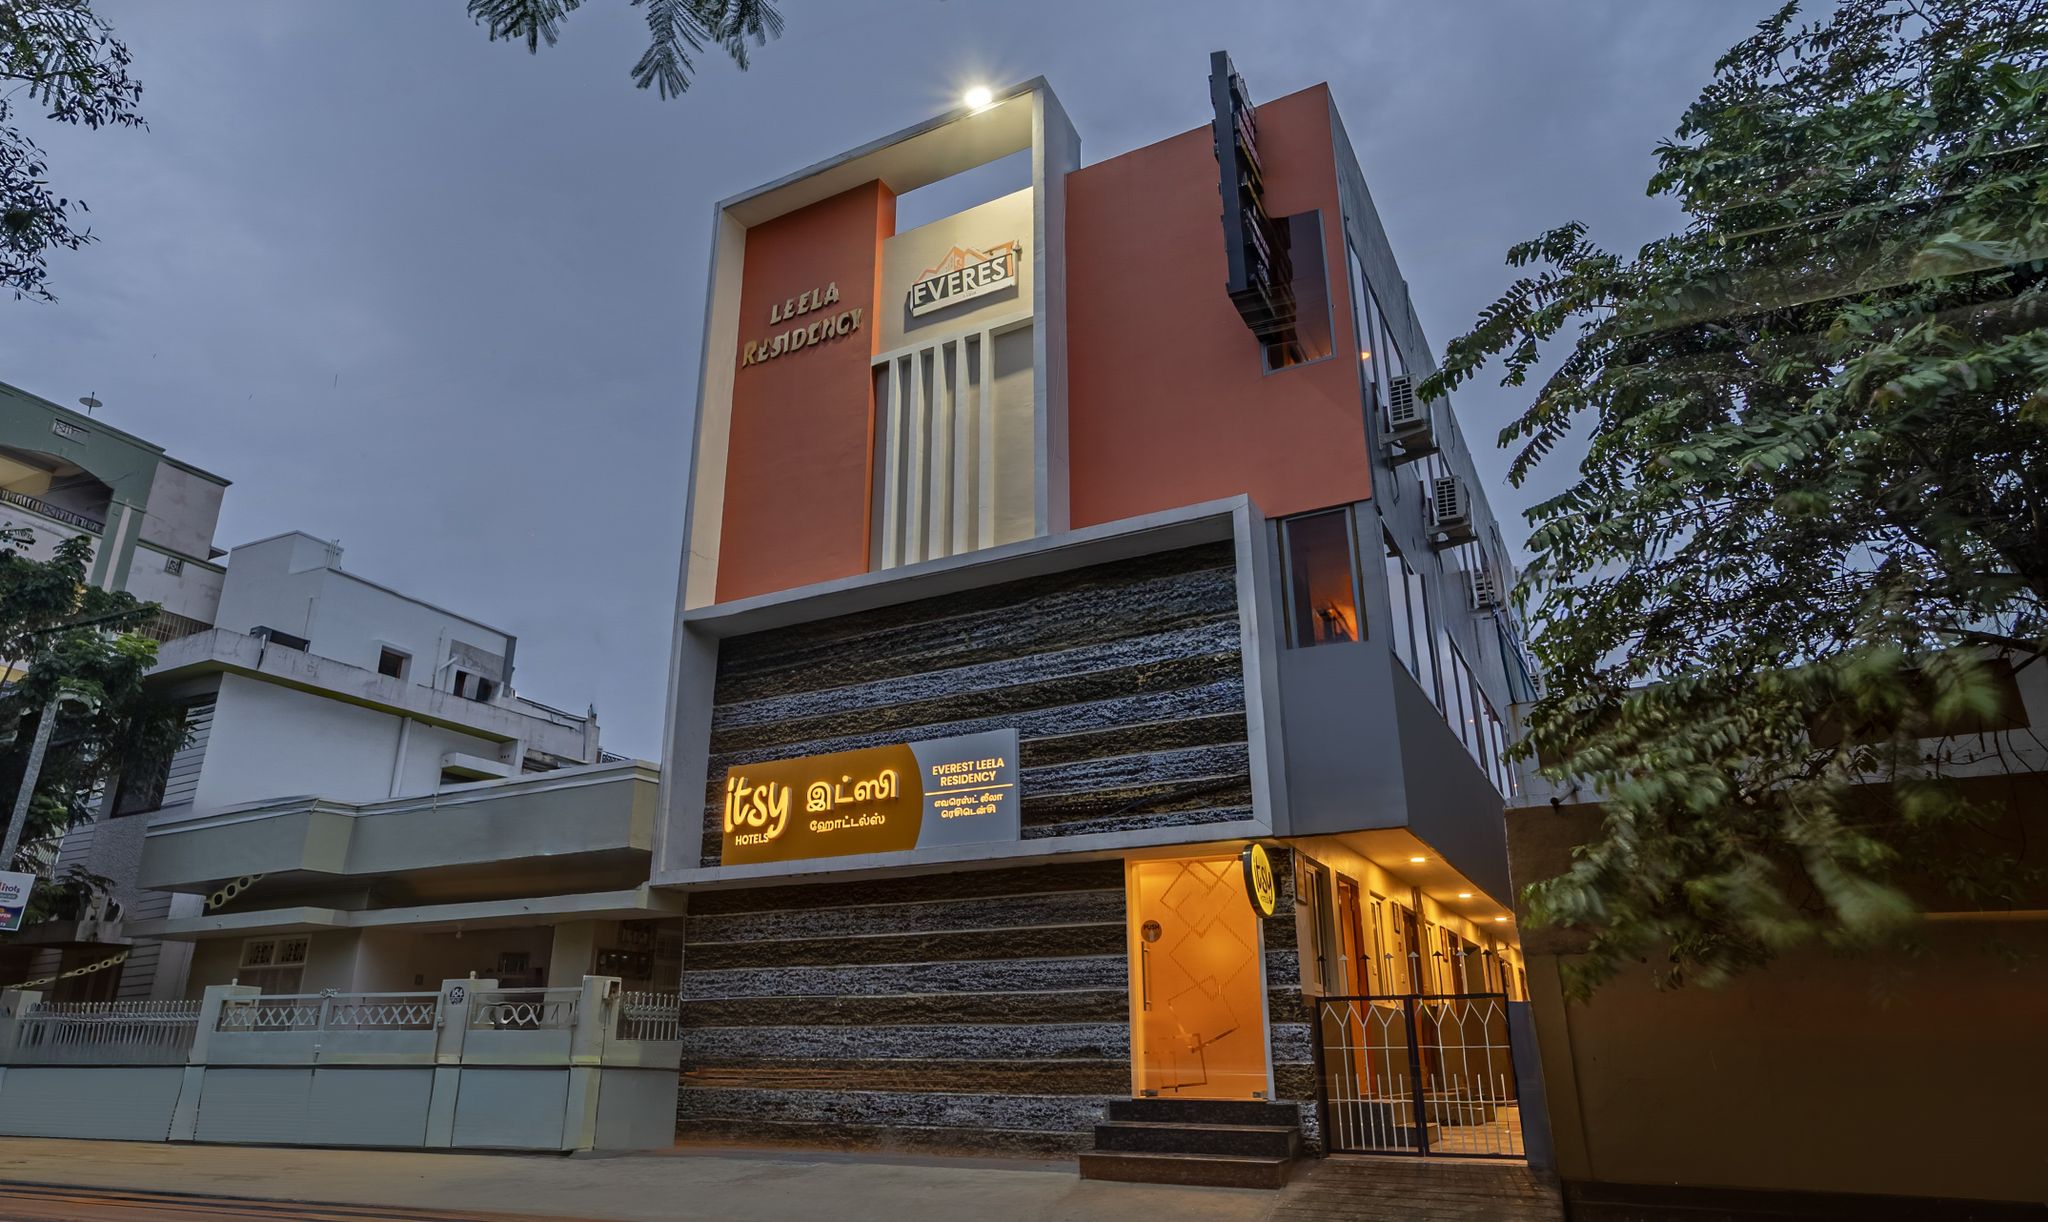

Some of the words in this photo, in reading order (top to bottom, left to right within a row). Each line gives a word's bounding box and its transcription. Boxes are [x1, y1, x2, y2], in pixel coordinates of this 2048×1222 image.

[913, 241, 1014, 305] EVEREST
[769, 281, 840, 326] LEELA
[742, 307, 863, 368] RESIDENCY
[932, 761, 975, 776] EVEREST
[976, 757, 1005, 770] LEELA
[940, 770, 997, 787] RESIDENCY
[723, 776, 792, 839] itsy
[806, 769, 898, 812] இட்ஸி
[735, 832, 769, 847] HOTELS
[809, 812, 886, 834] ஹோட்டல்ஸ்
